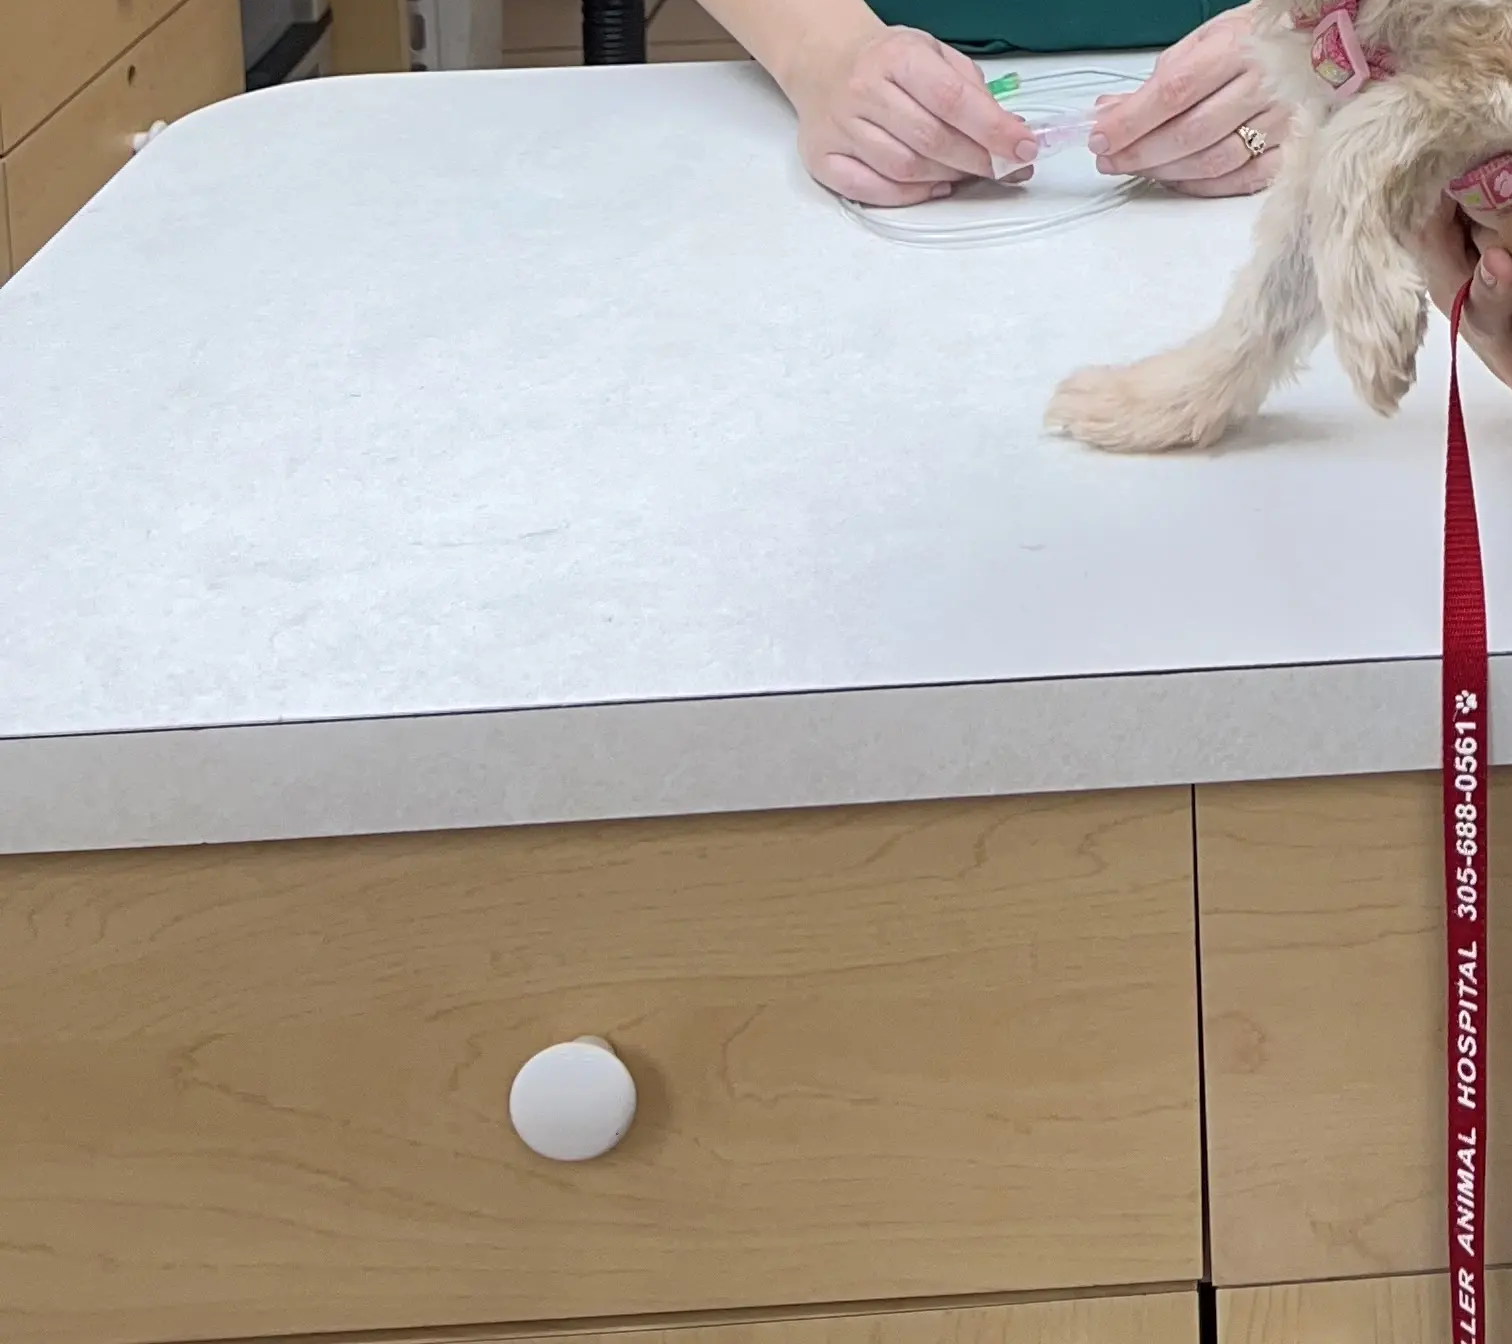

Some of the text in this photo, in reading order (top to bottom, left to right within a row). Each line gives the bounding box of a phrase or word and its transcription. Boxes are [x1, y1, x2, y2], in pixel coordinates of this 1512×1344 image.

[1454, 721, 1478, 922] 305-688-0561
[1456, 940, 1478, 1109] HOSPITAL
[1457, 1126, 1477, 1257] ANIMAL
